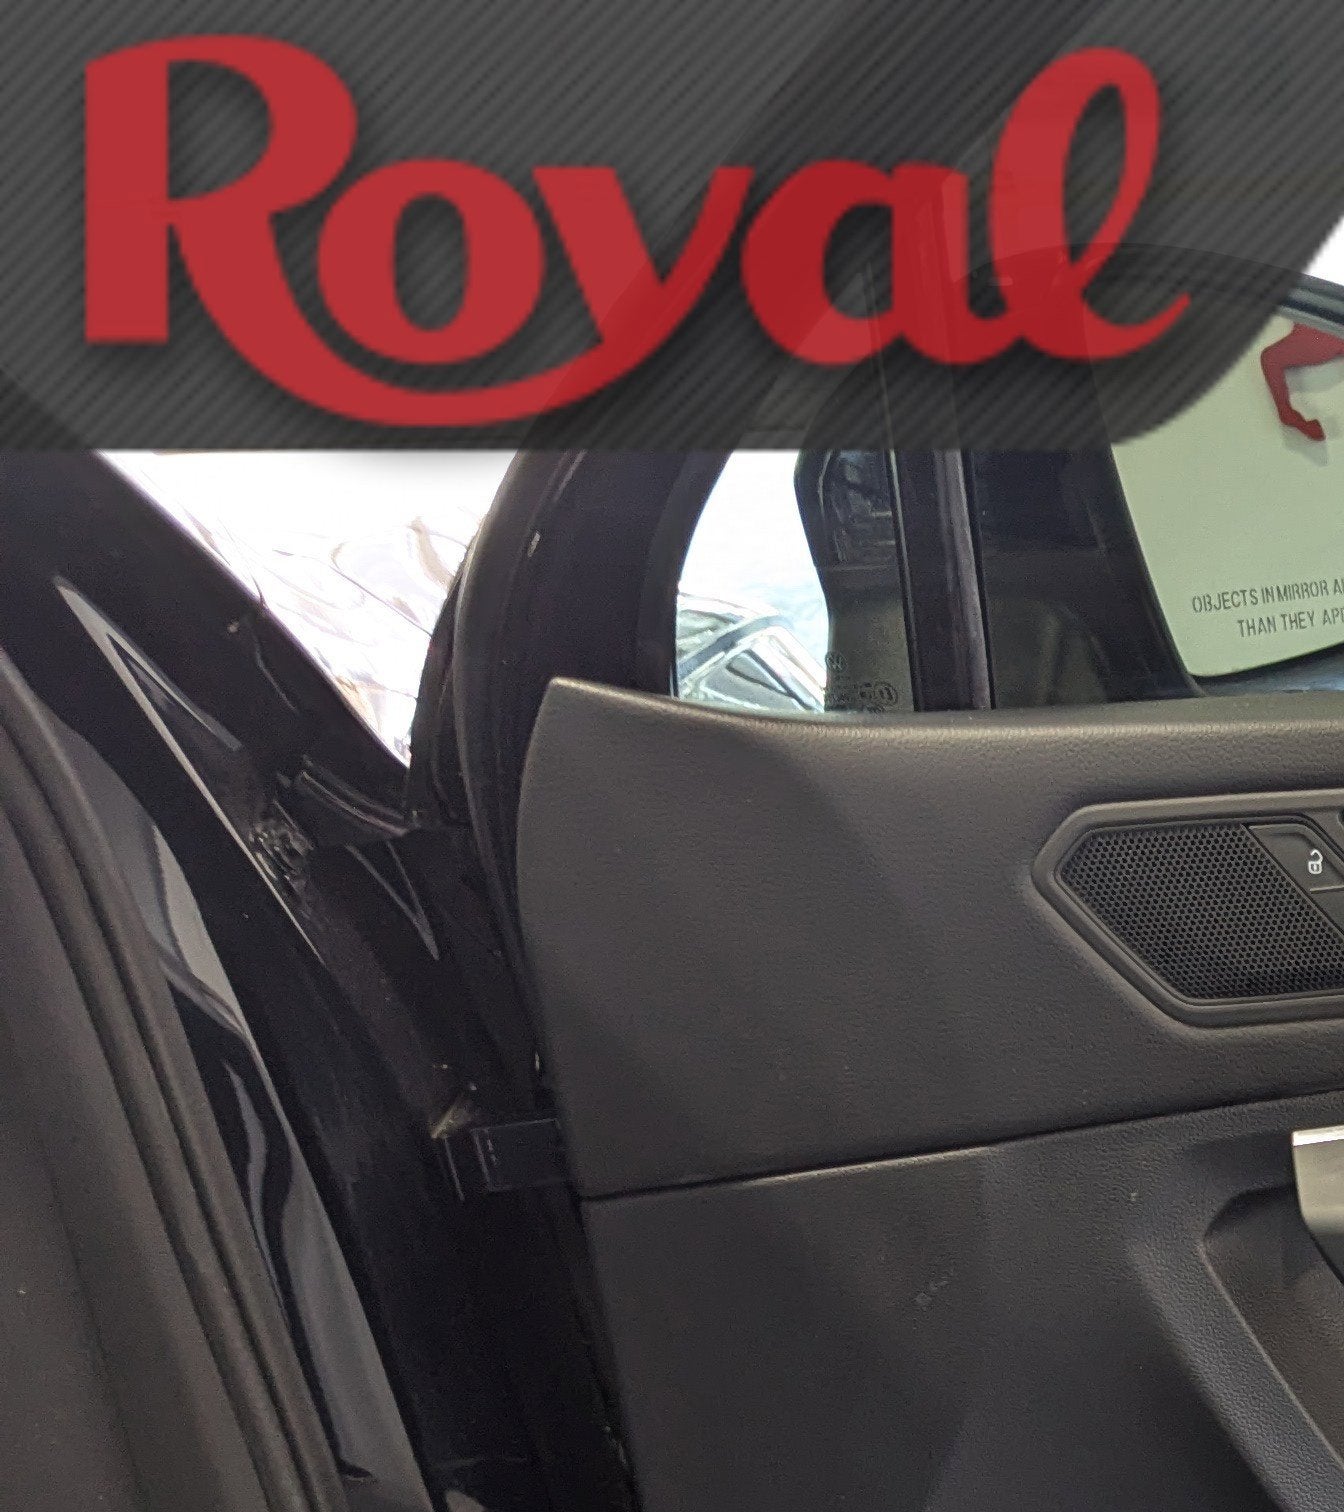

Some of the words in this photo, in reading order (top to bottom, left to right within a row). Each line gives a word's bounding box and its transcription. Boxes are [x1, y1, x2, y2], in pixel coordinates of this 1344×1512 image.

[1191, 588, 1259, 613] OBJECTS
[1260, 586, 1276, 604] IN
[1275, 579, 1330, 603] MIRROR
[1236, 613, 1278, 638] THAN
[1280, 610, 1316, 630] THEY
